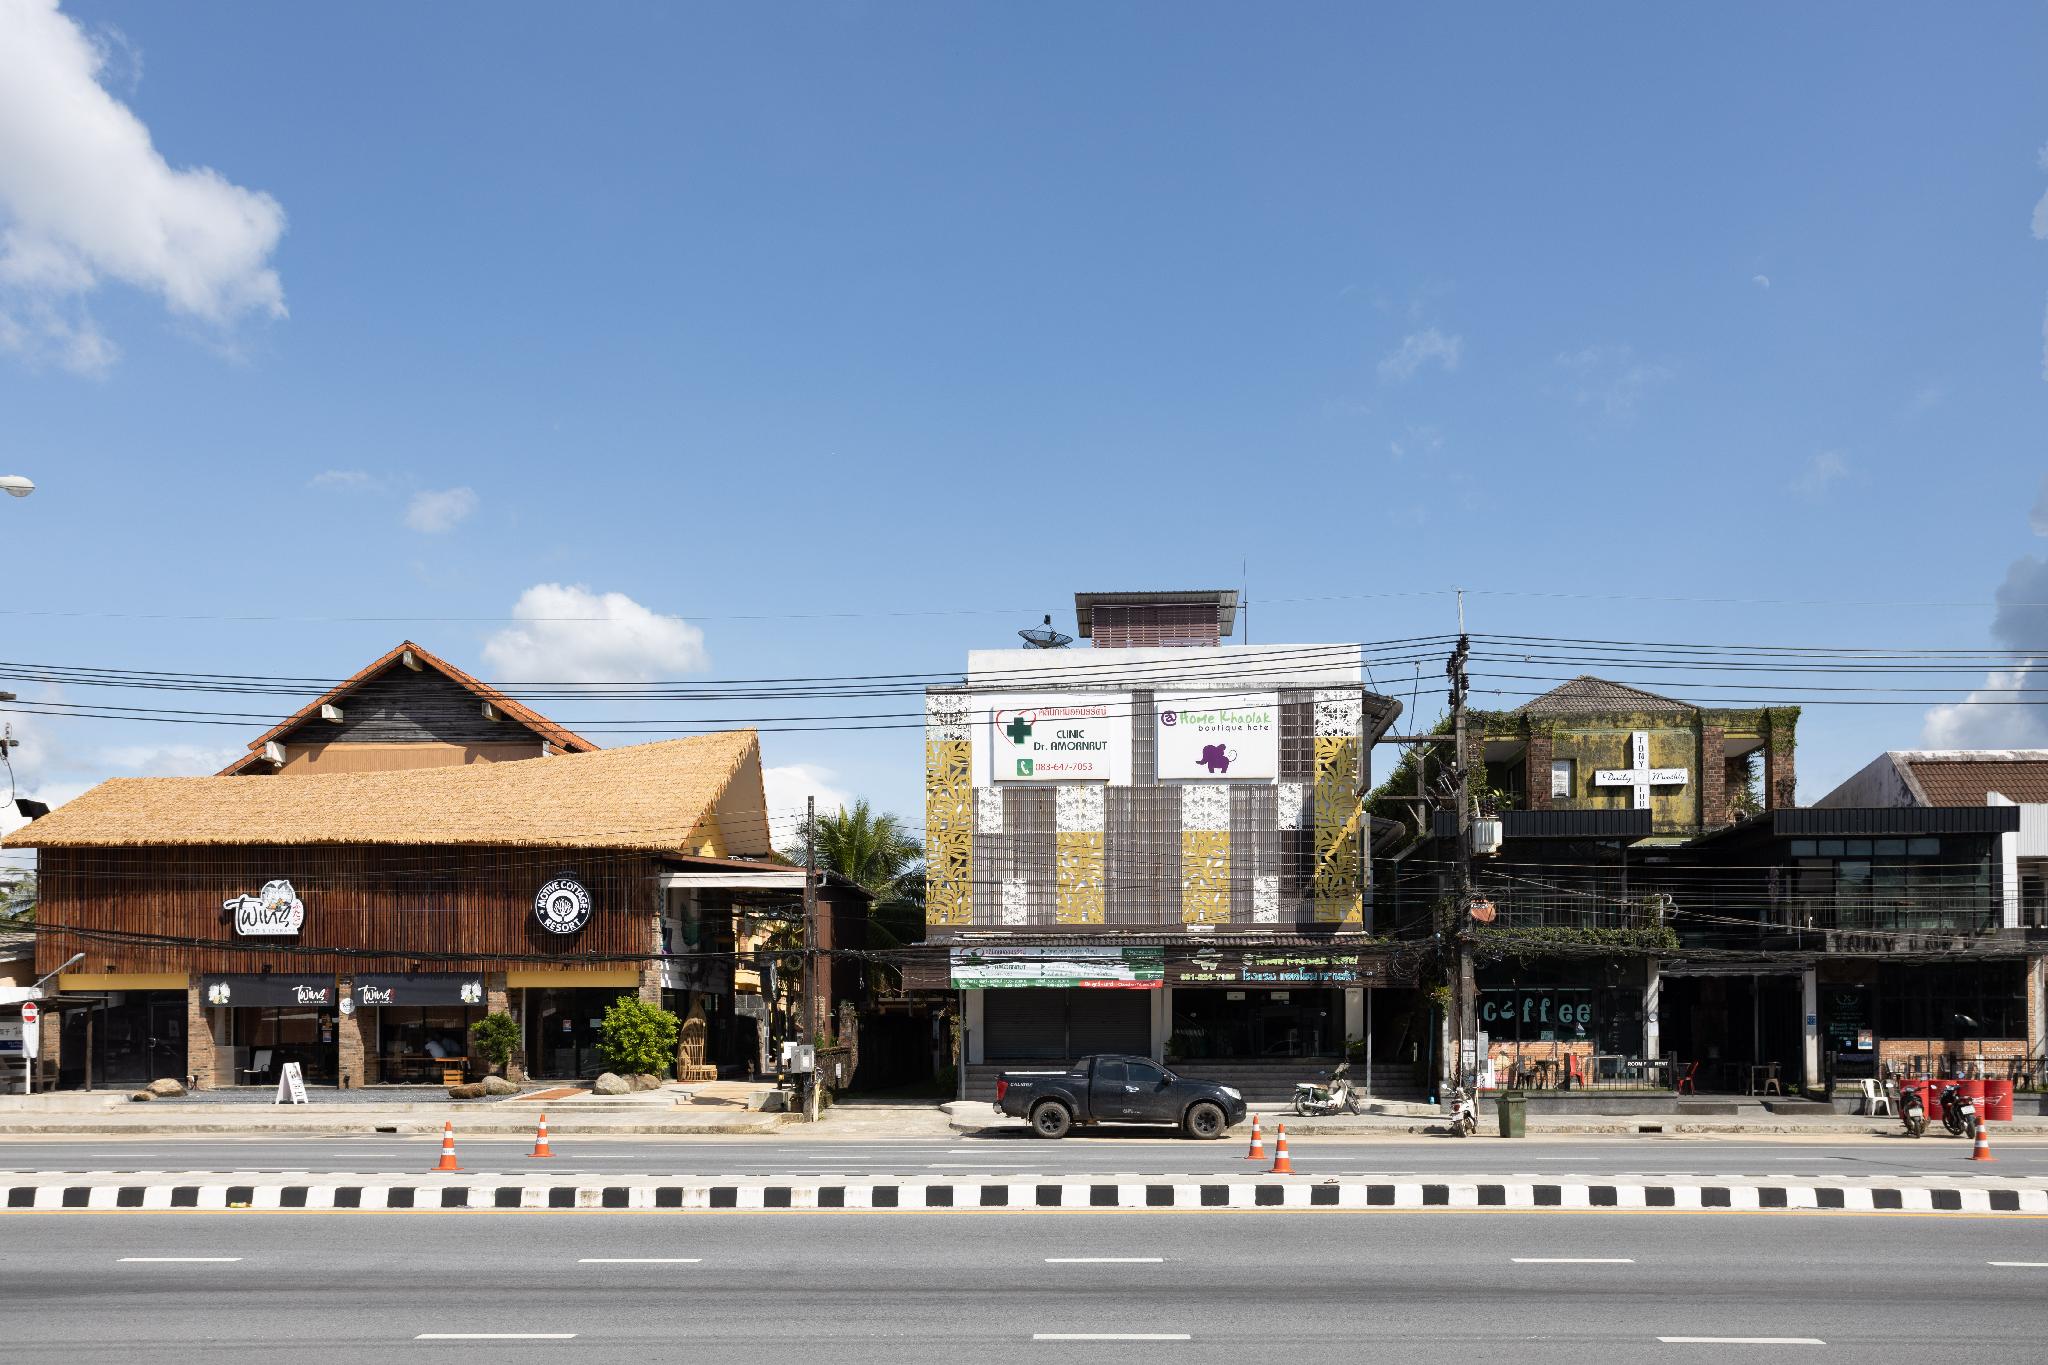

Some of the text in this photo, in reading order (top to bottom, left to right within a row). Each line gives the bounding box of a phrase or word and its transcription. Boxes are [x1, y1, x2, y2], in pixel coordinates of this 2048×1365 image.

[1220, 709, 1271, 723] Khaolak
[1056, 730, 1085, 739] CLINIC
[1198, 724, 1243, 732] boutique
[1033, 741, 1107, 750] Dr. AMORNRUT
[1637, 737, 1645, 768] TONY
[1602, 772, 1632, 784] Daily
[538, 881, 588, 909] MOTIVE COTTAGE
[225, 897, 291, 933] Twins
[544, 918, 581, 932] RESORT
